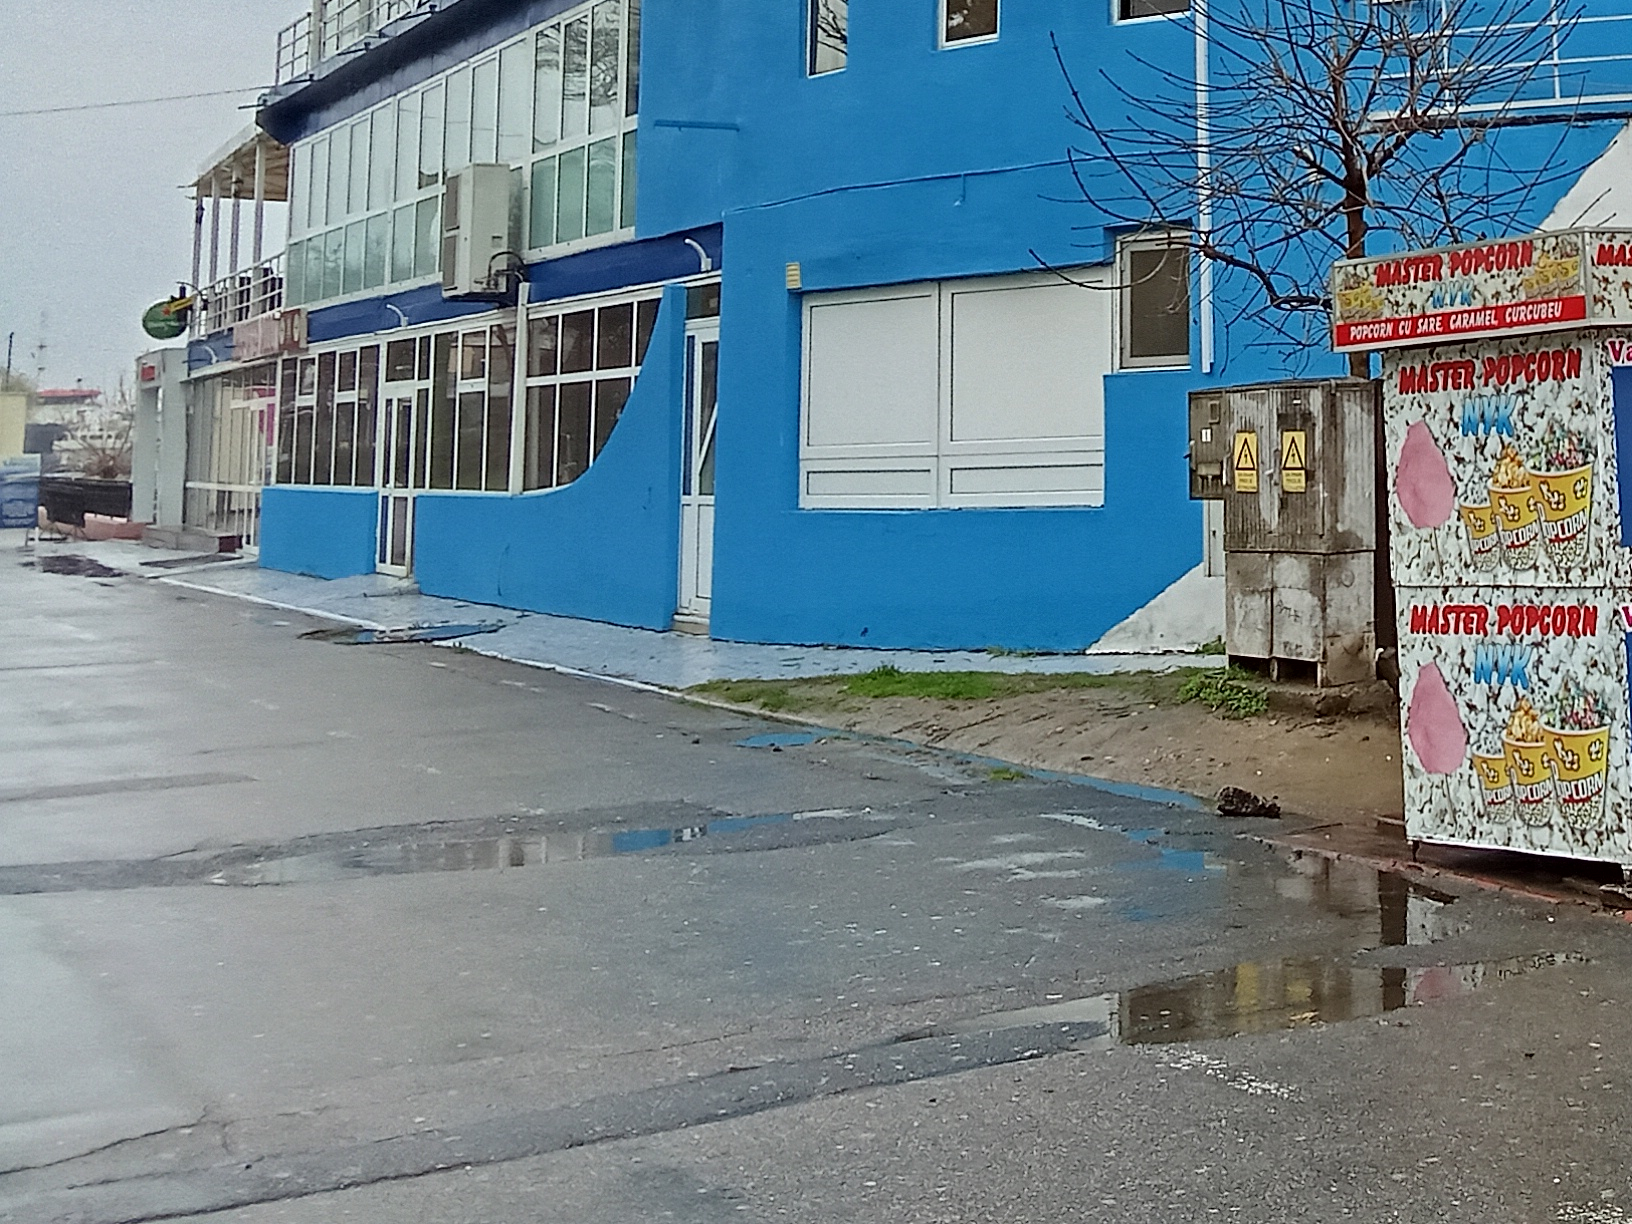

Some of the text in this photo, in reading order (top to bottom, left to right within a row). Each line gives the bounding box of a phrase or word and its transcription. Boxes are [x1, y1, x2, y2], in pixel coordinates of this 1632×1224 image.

[1374, 241, 1534, 288] MASTER POPCORN
[1349, 301, 1563, 341] POPCORN CU SARE, CARAMEL, CURCUBEU
[1398, 347, 1582, 395] MASTER POPCORN
[1461, 393, 1519, 438] NYK
[1410, 604, 1598, 639] MASTER POPCORN
[1473, 643, 1534, 690] NYK
